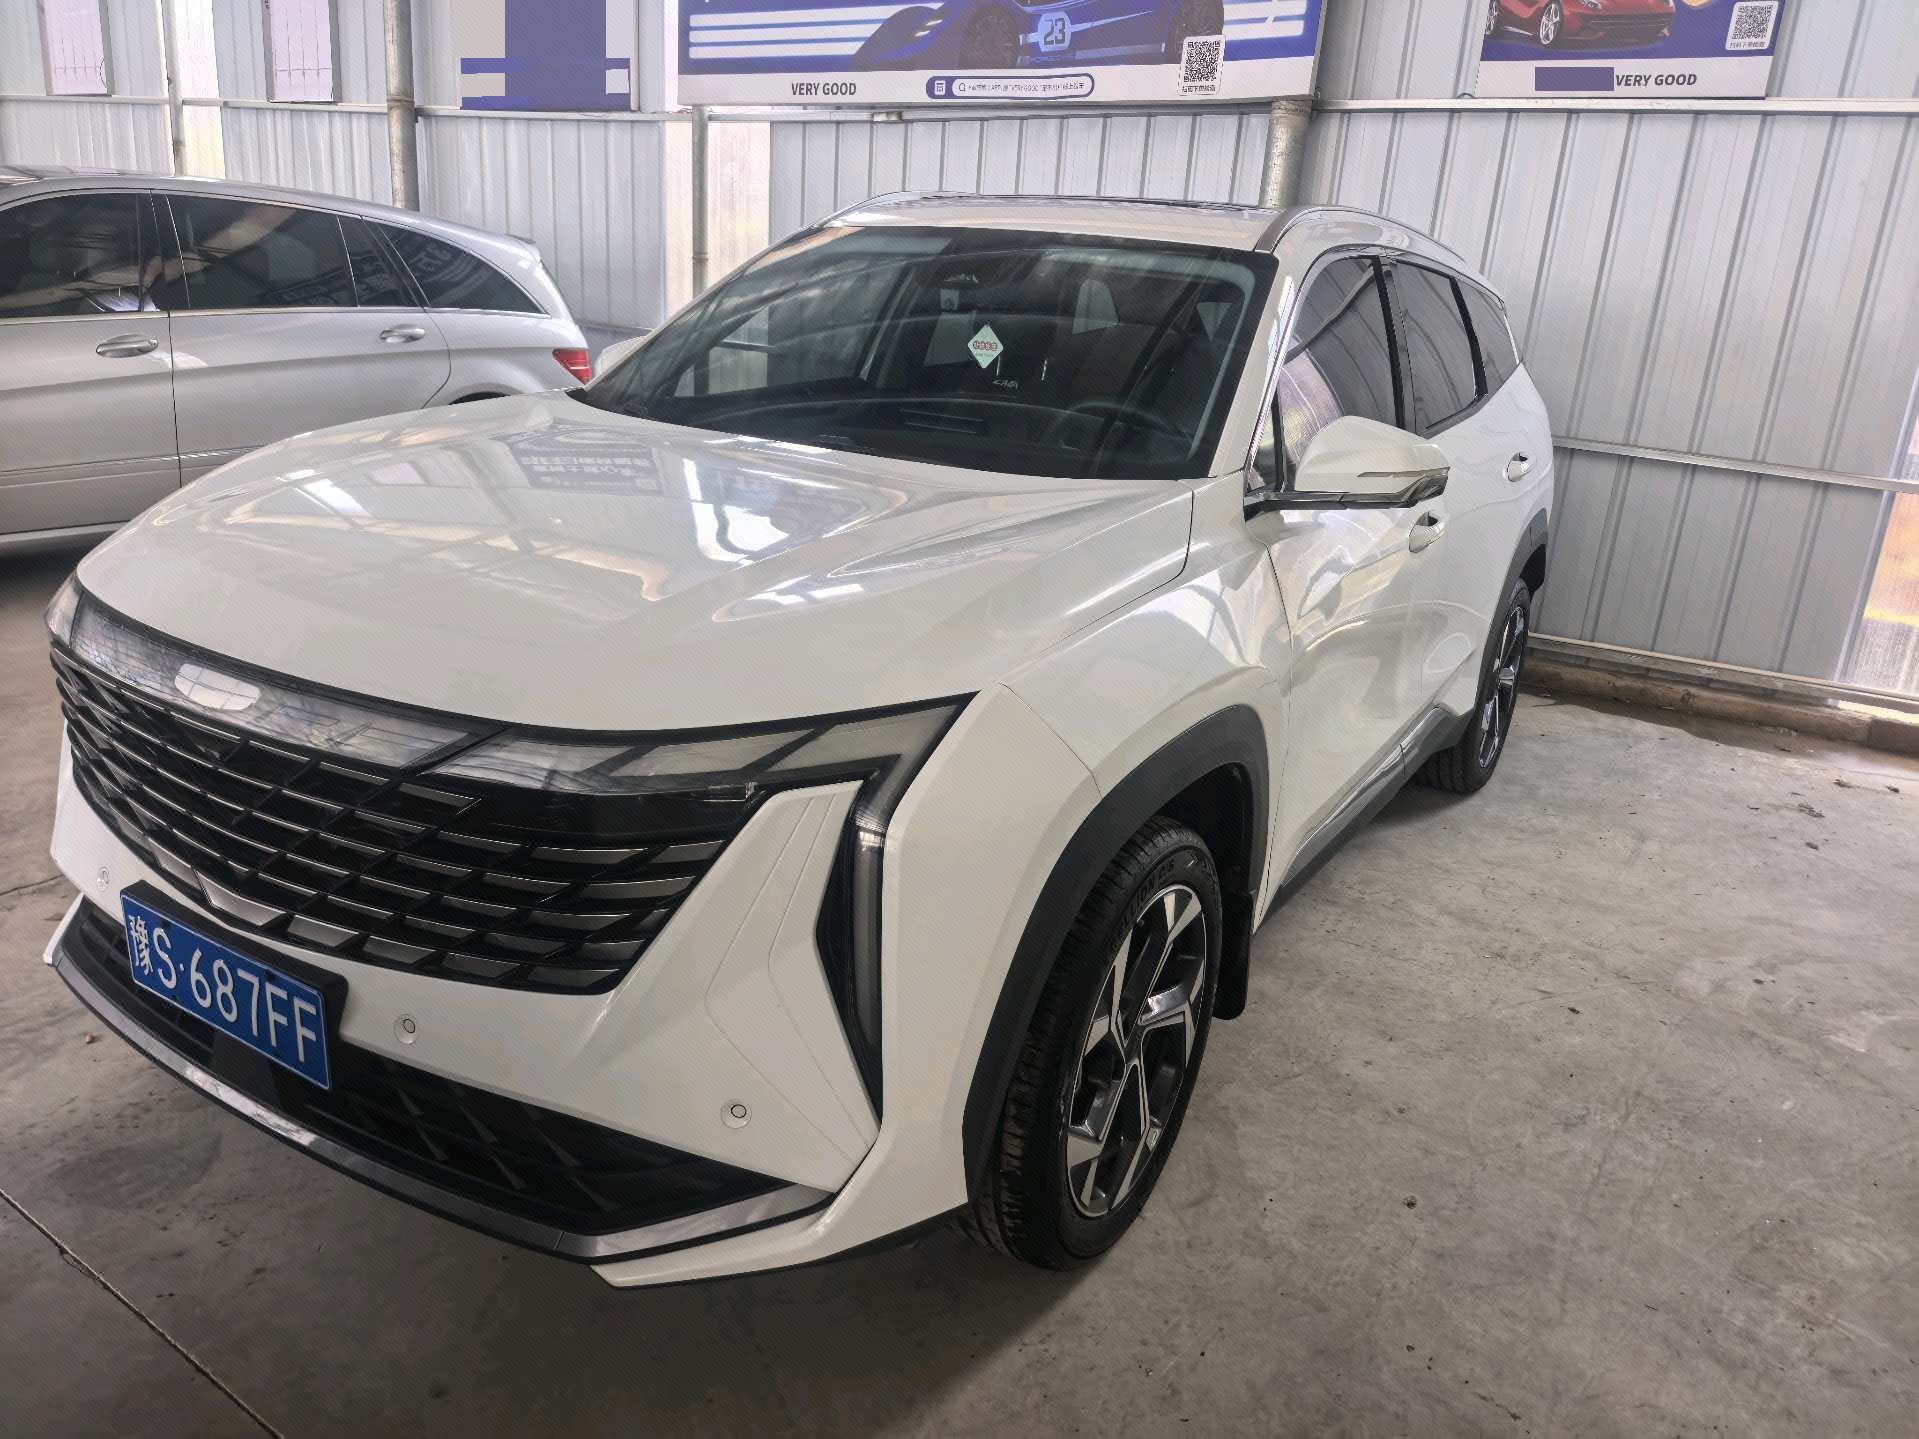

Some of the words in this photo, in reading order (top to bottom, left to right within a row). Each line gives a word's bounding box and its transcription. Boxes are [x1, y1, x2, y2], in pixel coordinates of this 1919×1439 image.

[1043, 17, 1066, 45] 23
[791, 82, 819, 95] VERY
[822, 82, 856, 95] GOOD
[1615, 73, 1652, 87] VERY
[1654, 73, 1697, 86] GOOD
[128, 915, 316, 1063] 豫S·687FF
